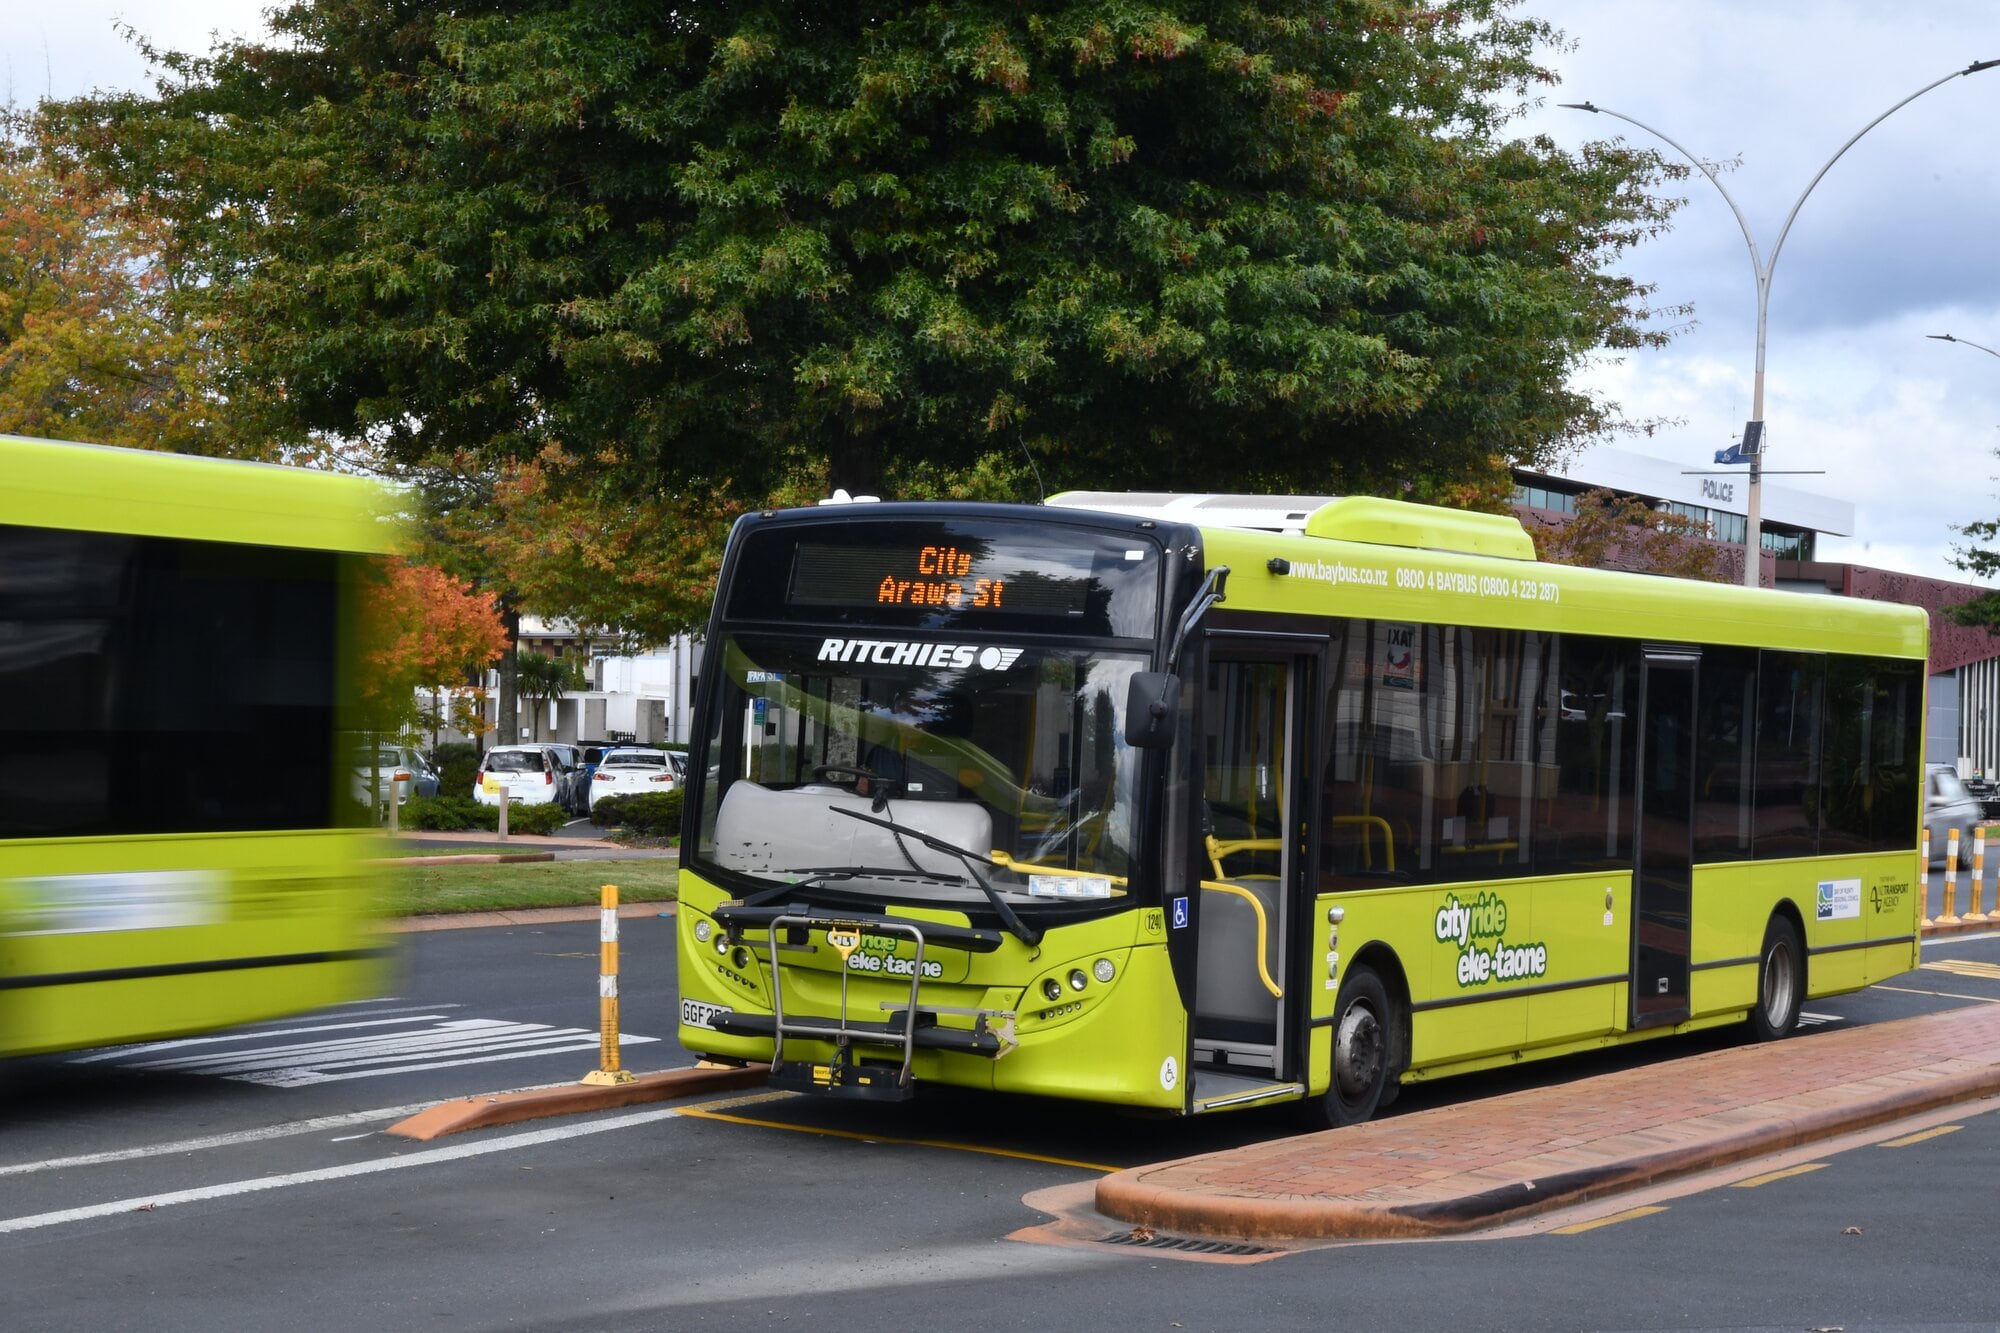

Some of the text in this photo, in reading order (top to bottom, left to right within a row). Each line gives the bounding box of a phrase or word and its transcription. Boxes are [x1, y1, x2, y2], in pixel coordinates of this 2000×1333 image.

[1703, 478, 1734, 502] POLICE
[919, 547, 972, 575] City
[1289, 559, 1388, 586] www.baybus.co.nz
[878, 575, 1003, 607] Arawa St
[1396, 567, 1560, 604] 0800 4 BAYBUS (0800 4 229 287)
[817, 638, 979, 669] RITCHIES
[1884, 883, 1909, 895] TRANSPORT
